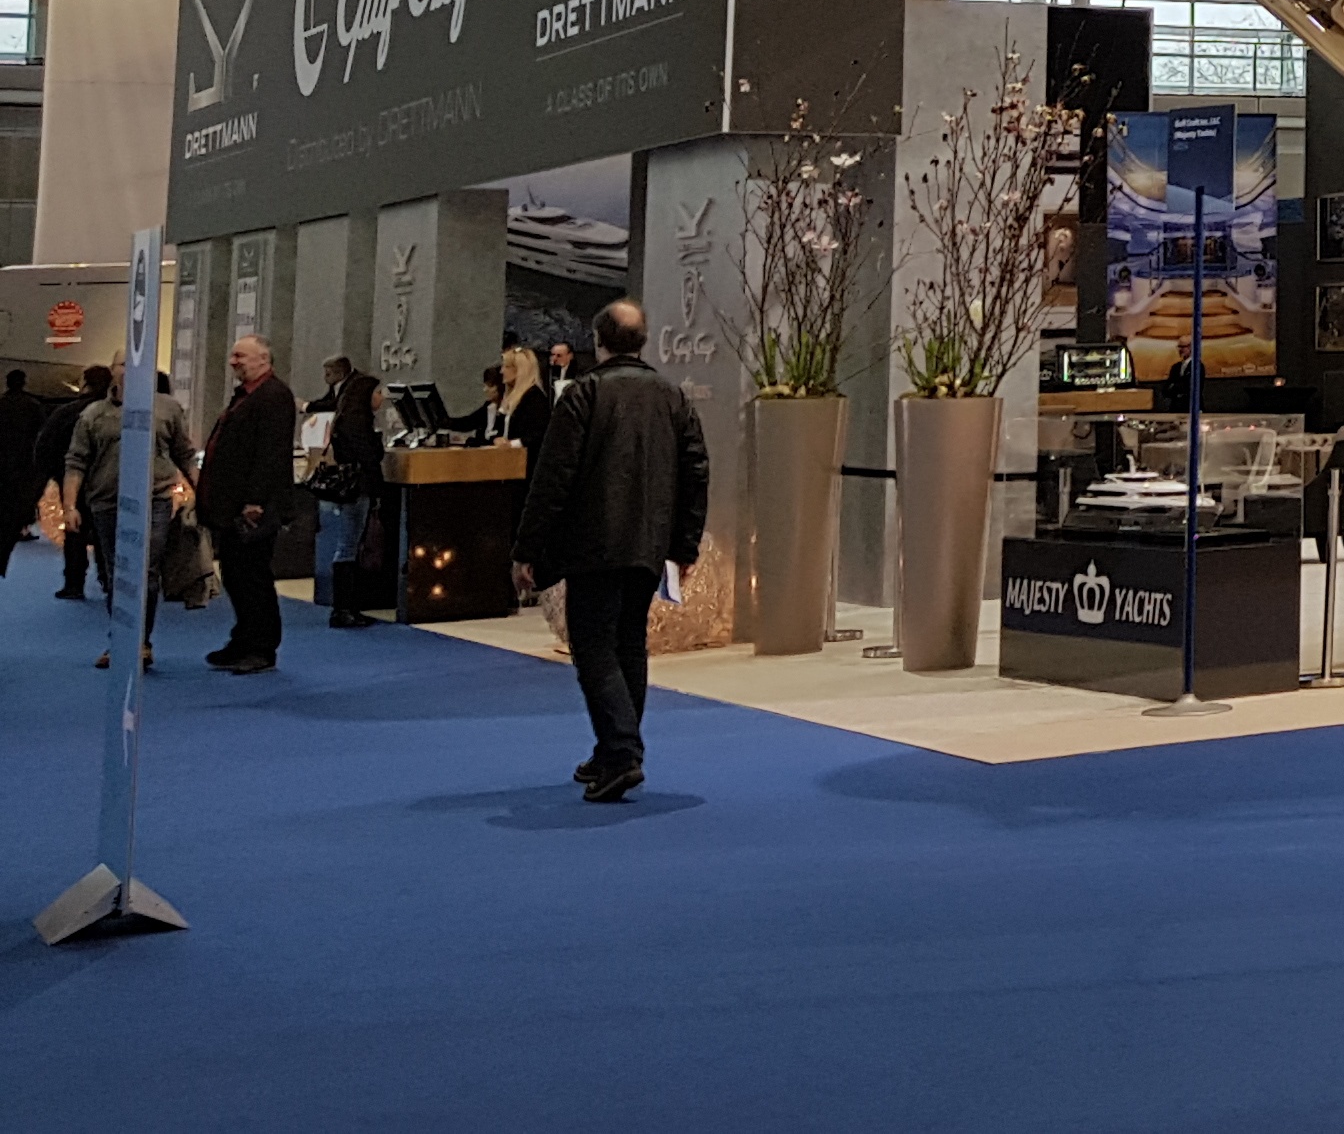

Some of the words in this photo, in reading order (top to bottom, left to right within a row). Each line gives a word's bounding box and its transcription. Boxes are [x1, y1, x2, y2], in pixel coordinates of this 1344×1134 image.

[184, 112, 259, 160] DRETTMANN
[1005, 576, 1069, 616] MAJESTY
[1114, 587, 1173, 627] YACHTS
